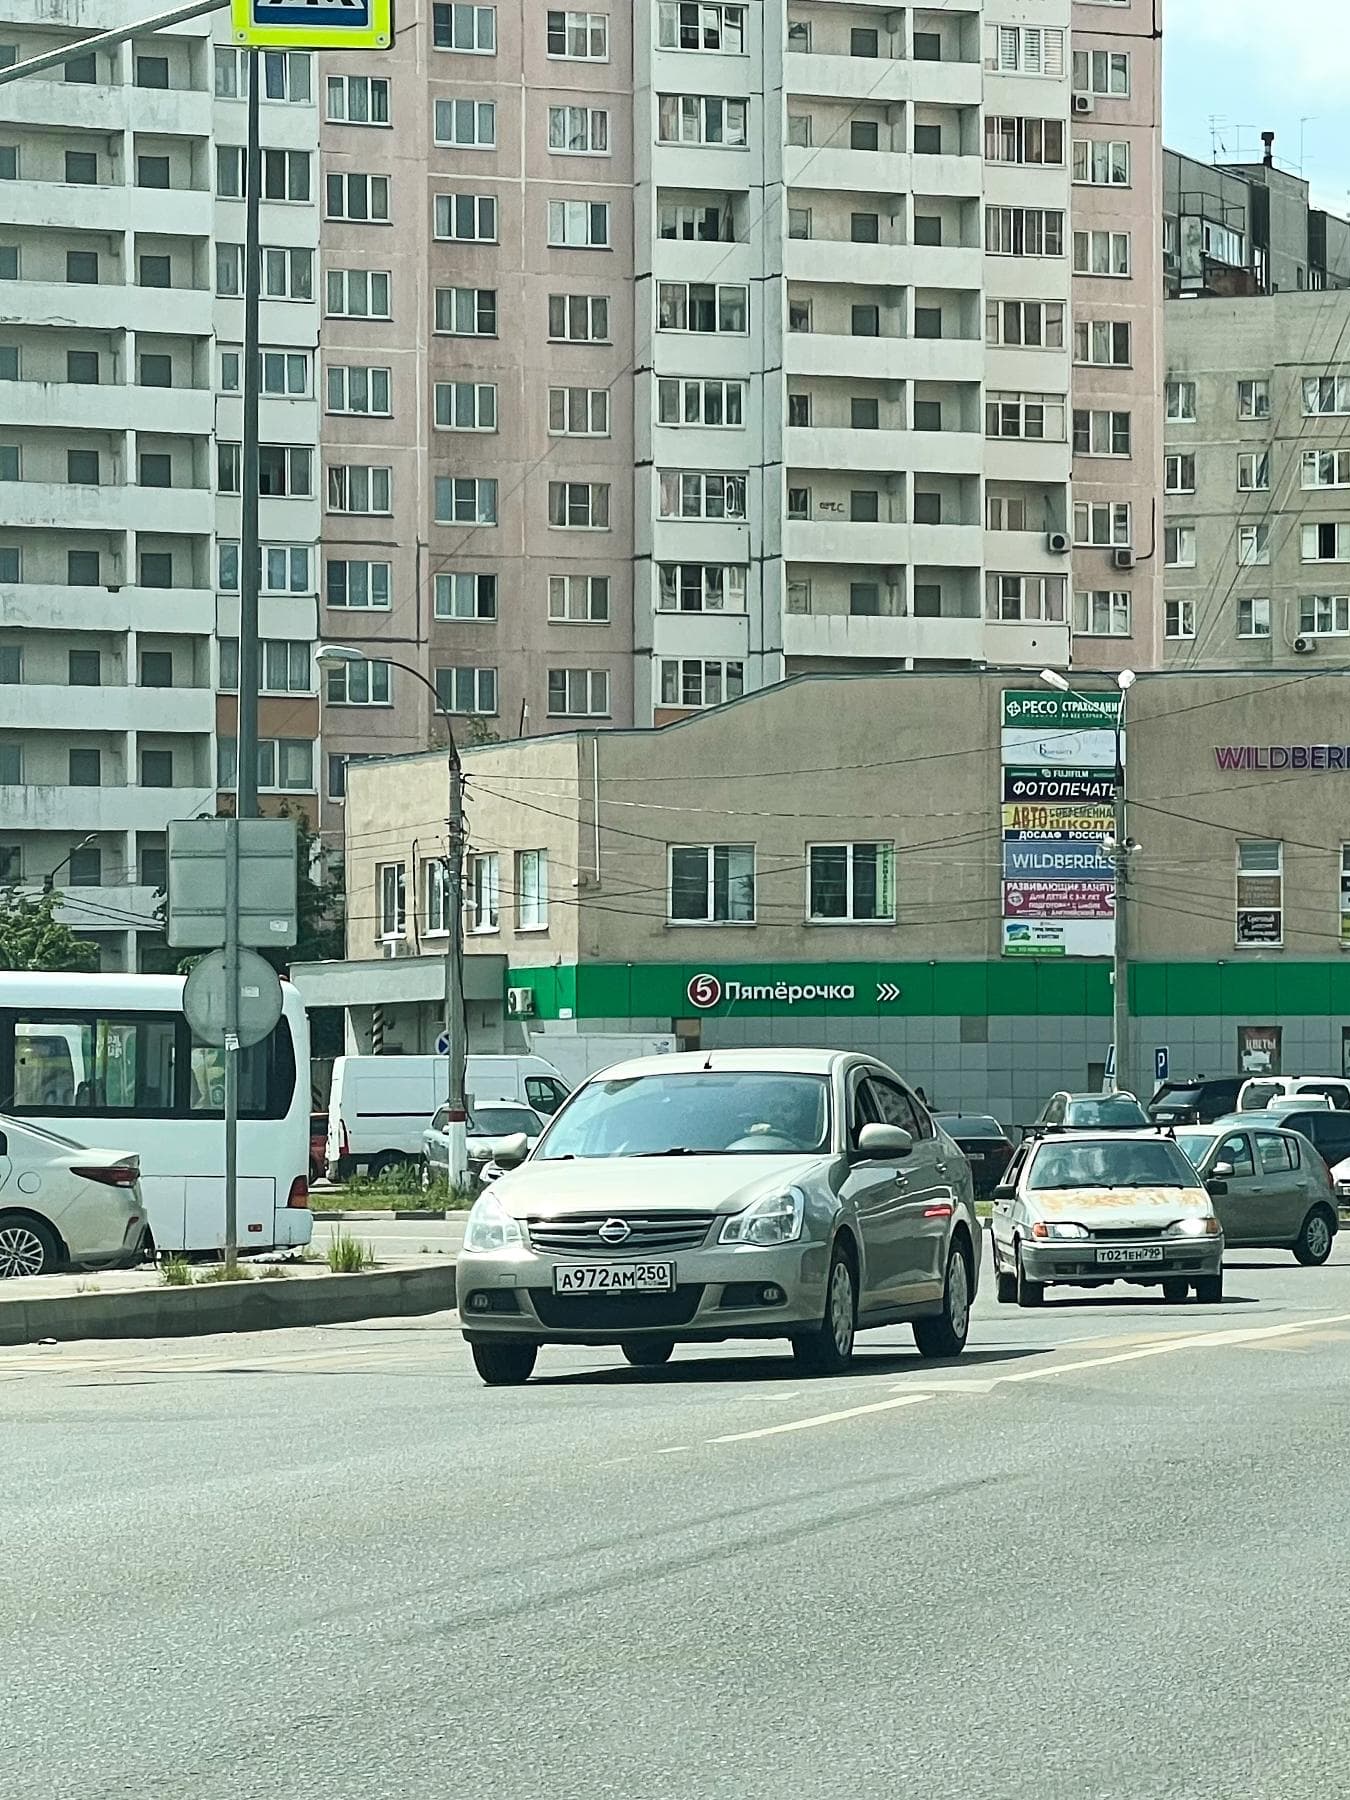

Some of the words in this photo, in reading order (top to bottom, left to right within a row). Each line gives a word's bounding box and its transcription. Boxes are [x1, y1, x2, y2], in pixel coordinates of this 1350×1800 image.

[1022, 700, 1058, 715] РЕСО
[1019, 831, 1061, 840] ДОСААФ
[725, 981, 855, 1004] Пятёрочка
[561, 1268, 635, 1289] А972АМ
[637, 1266, 666, 1281] 250
